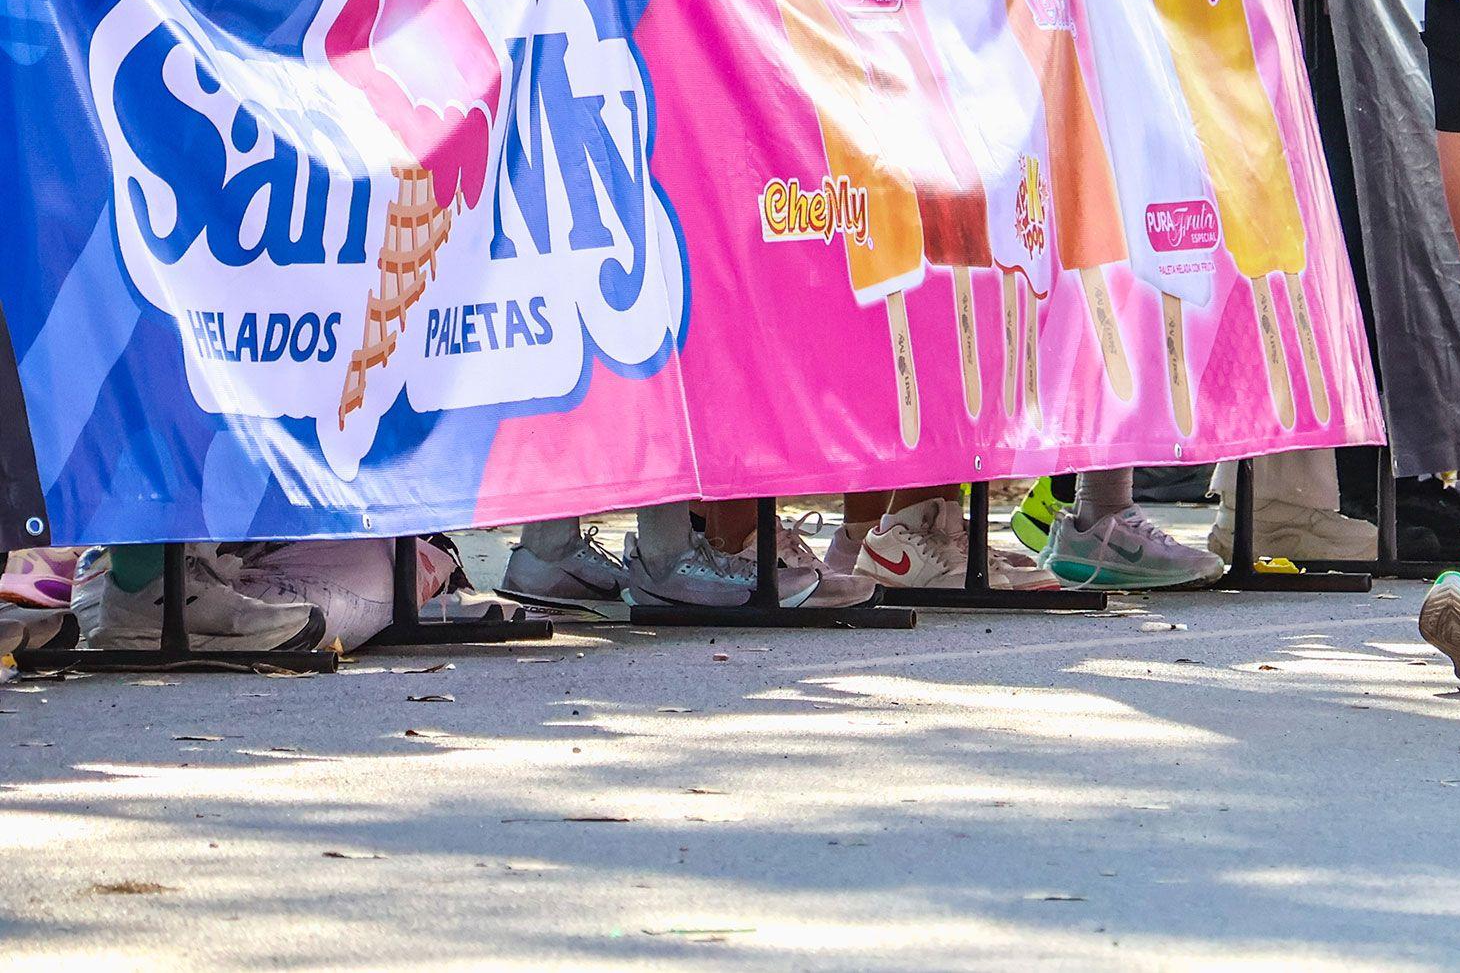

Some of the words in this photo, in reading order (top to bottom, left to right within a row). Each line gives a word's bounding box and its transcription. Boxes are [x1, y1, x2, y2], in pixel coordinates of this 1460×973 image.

[112, 18, 374, 266] San
[489, 31, 648, 312] My
[1146, 210, 1176, 233] PURA
[1167, 202, 1217, 248] Fruta
[1190, 231, 1217, 244] ESPECIAL
[187, 308, 342, 364] HELADOS
[424, 295, 555, 359] PALETAS
